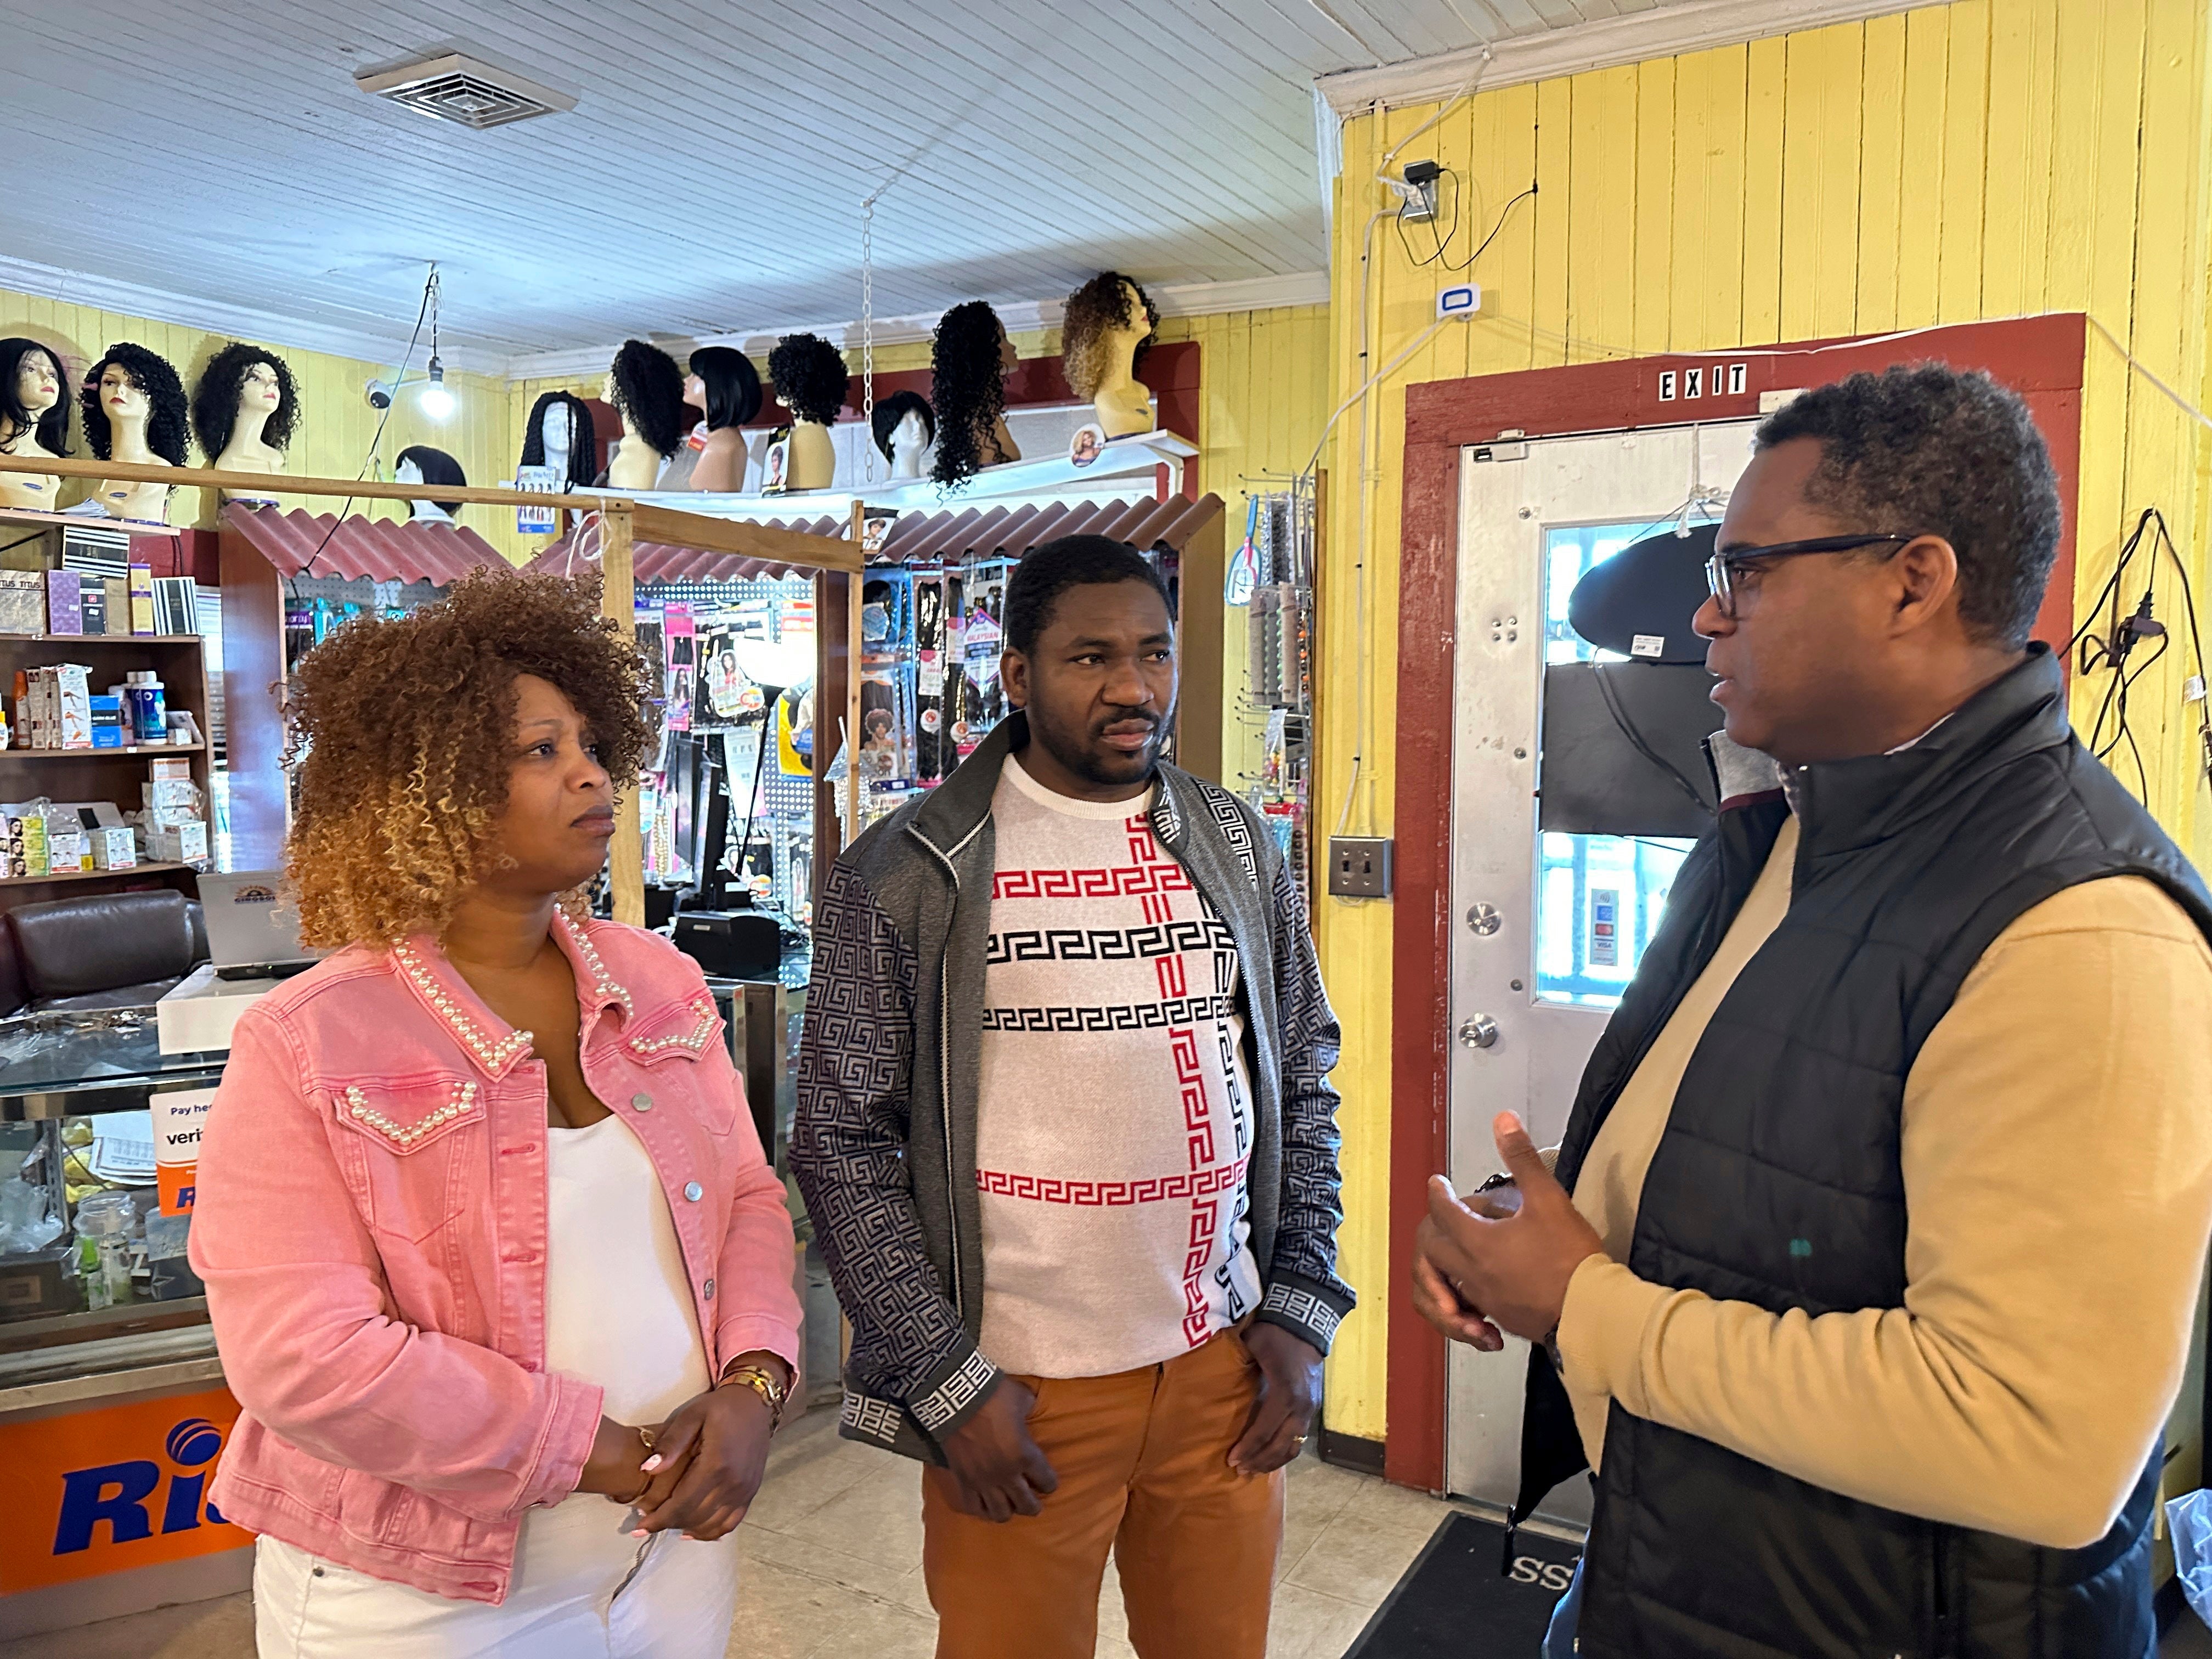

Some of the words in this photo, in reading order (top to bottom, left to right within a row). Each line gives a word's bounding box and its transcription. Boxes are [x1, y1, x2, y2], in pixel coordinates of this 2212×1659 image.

[1661, 366, 1744, 399] EXIT
[19, 580, 41, 589] TITUS
[171, 1107, 191, 1115] Pay
[166, 1128, 204, 1146] veri
